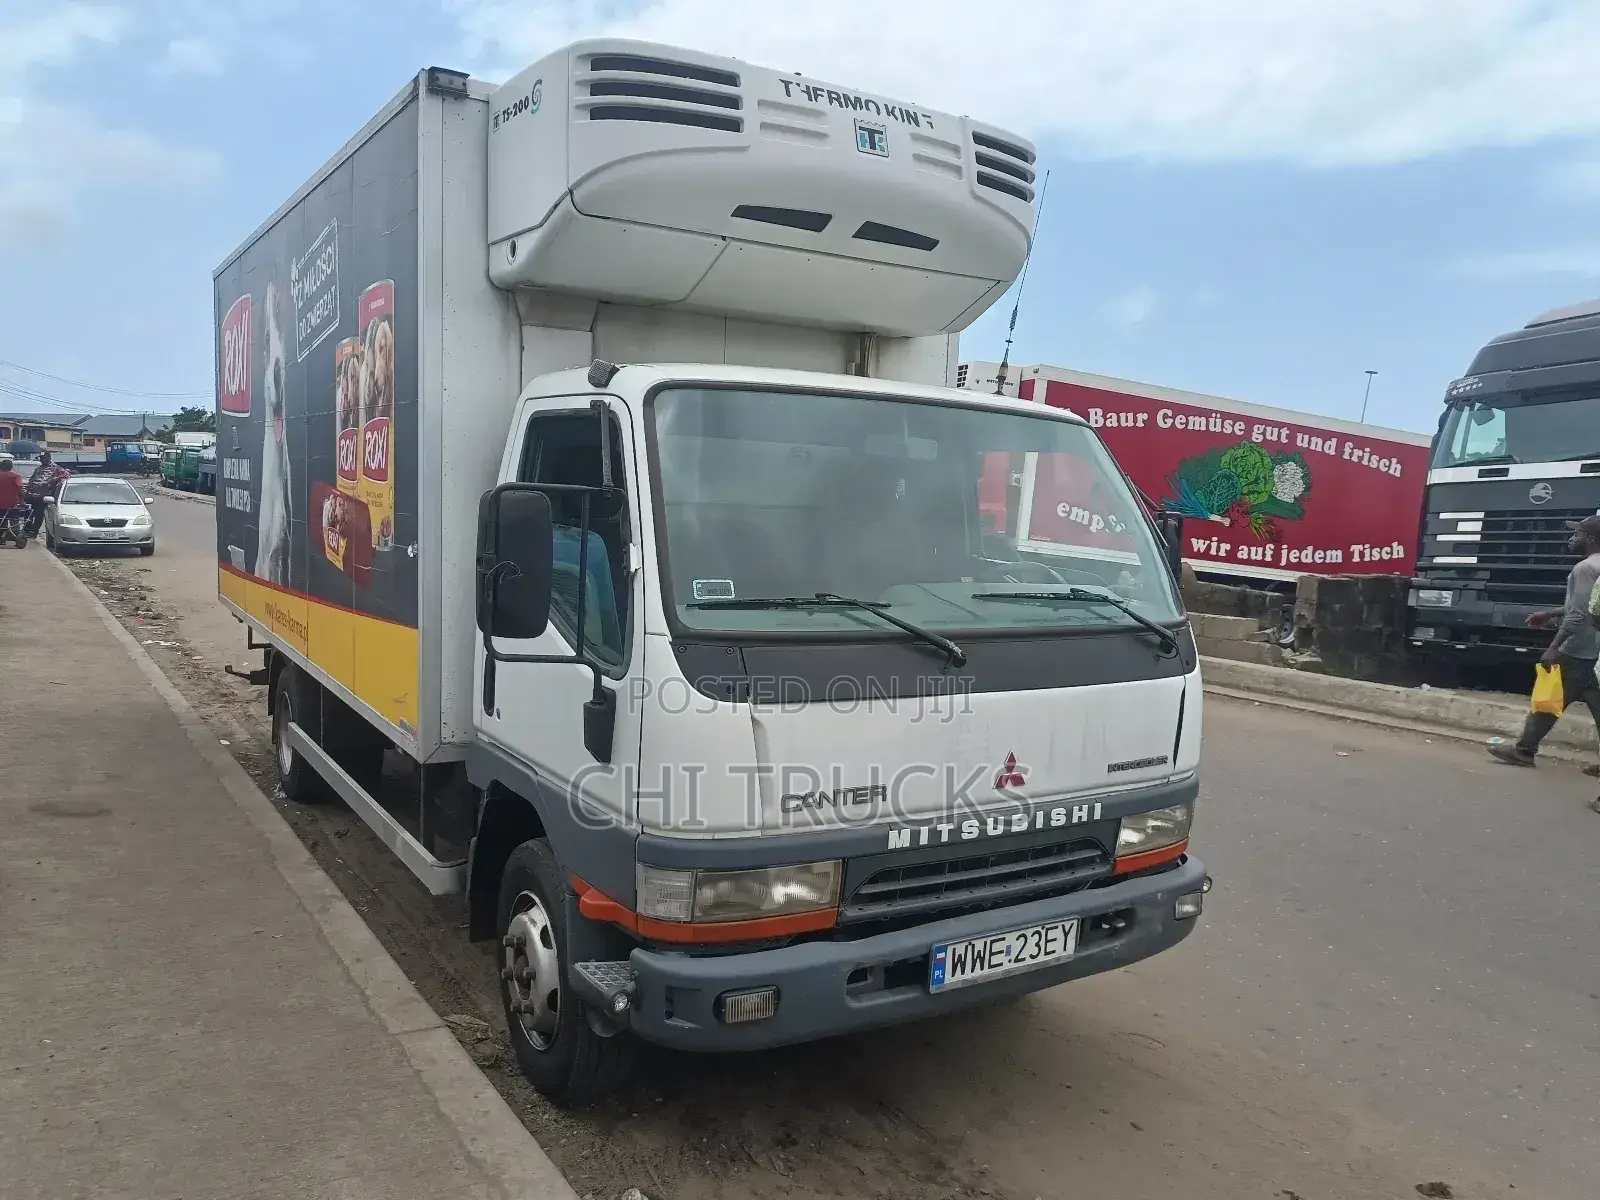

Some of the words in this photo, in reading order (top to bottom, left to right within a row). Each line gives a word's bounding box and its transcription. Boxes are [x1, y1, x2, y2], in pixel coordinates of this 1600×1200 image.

[502, 95, 530, 124] TS-200
[224, 310, 249, 397] ROXI
[339, 432, 357, 472] ROXI
[365, 425, 389, 470] ROXI
[1087, 407, 1149, 428] Baur
[1156, 408, 1247, 436] Gemüse
[1251, 423, 1291, 444] gut
[1296, 432, 1338, 456] und
[1342, 441, 1402, 478] frisch
[1190, 536, 1231, 557] wir
[1236, 543, 1275, 562] auf
[1279, 544, 1343, 566] jedem
[1350, 541, 1405, 563] Tisch
[780, 783, 888, 814] CANTER
[887, 802, 1103, 850] MITSUBISHI
[950, 936, 1007, 978] WWE
[1013, 922, 1075, 964] 23EY
[934, 970, 944, 980] PL
